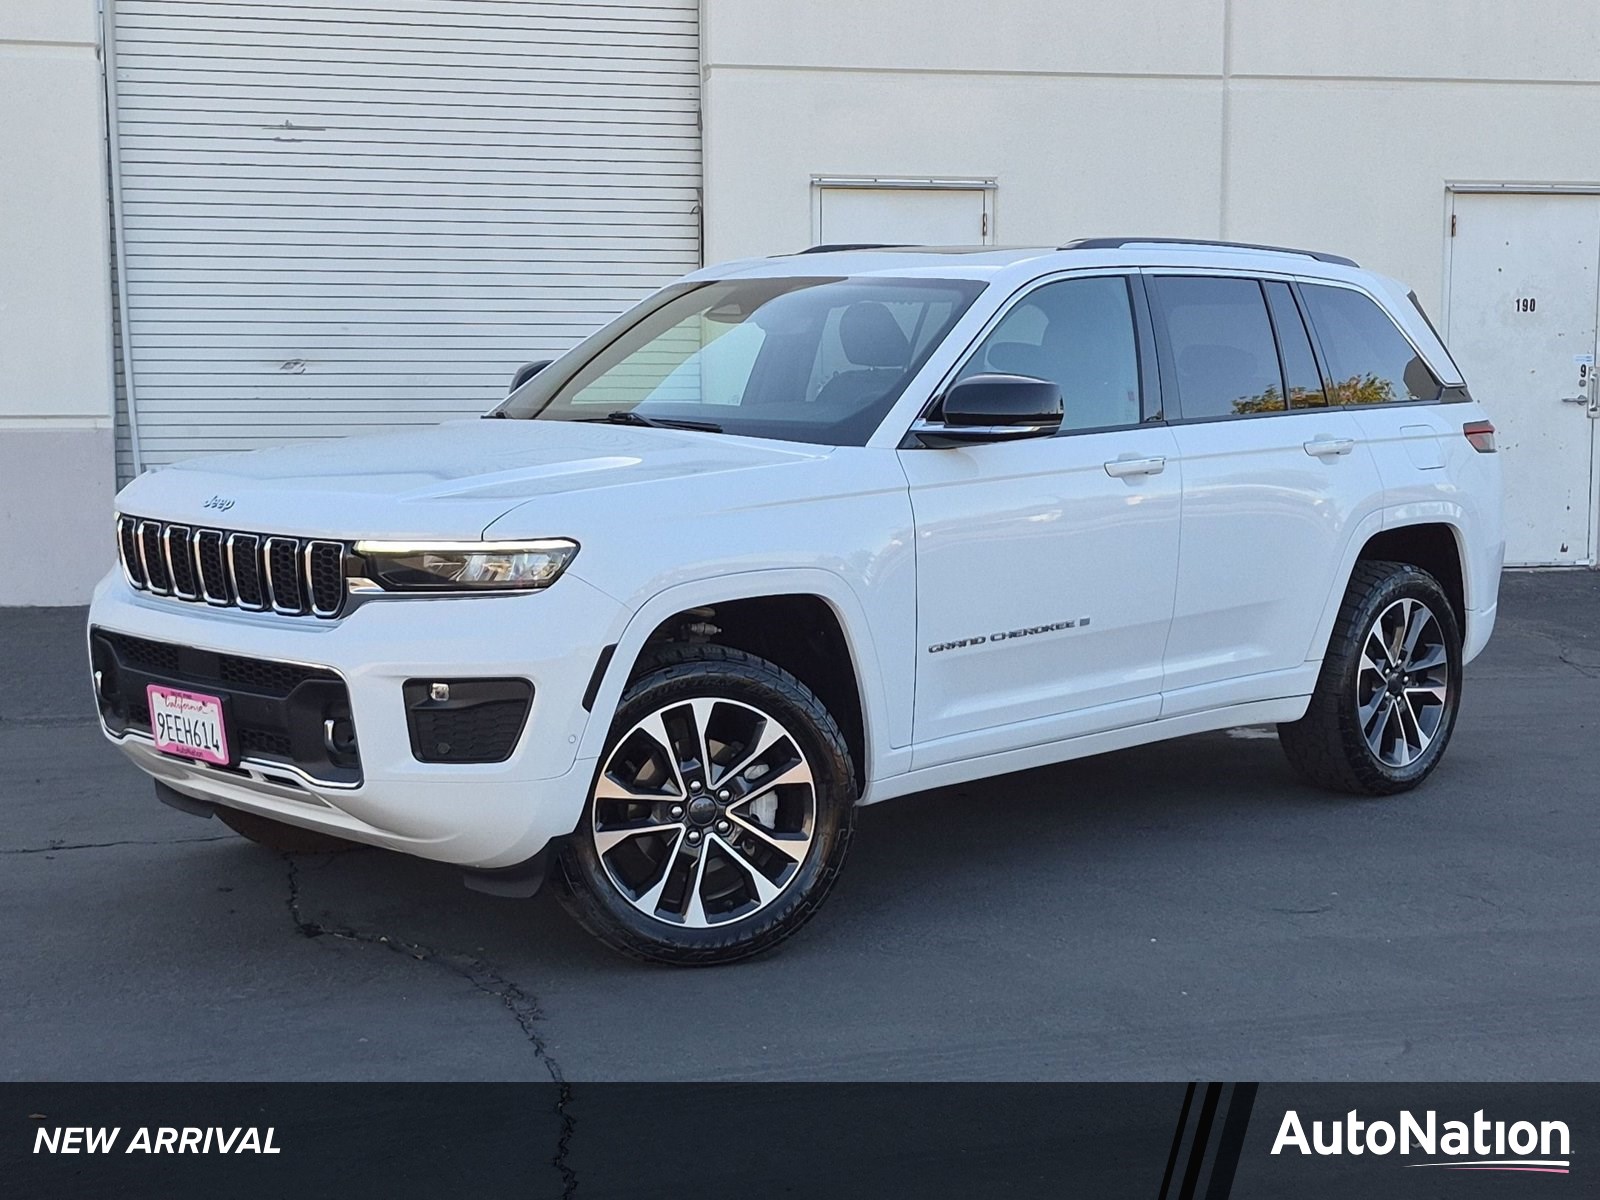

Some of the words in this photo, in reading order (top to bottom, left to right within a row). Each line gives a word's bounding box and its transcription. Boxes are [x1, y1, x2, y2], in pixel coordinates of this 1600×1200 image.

[1516, 298, 1536, 312] 190
[1580, 364, 1587, 378] 9
[204, 496, 235, 512] Jeep
[928, 636, 986, 653] GRAND
[990, 620, 1075, 642] CHEROKEE
[165, 695, 203, 713] California
[157, 712, 219, 752] 9EEH614
